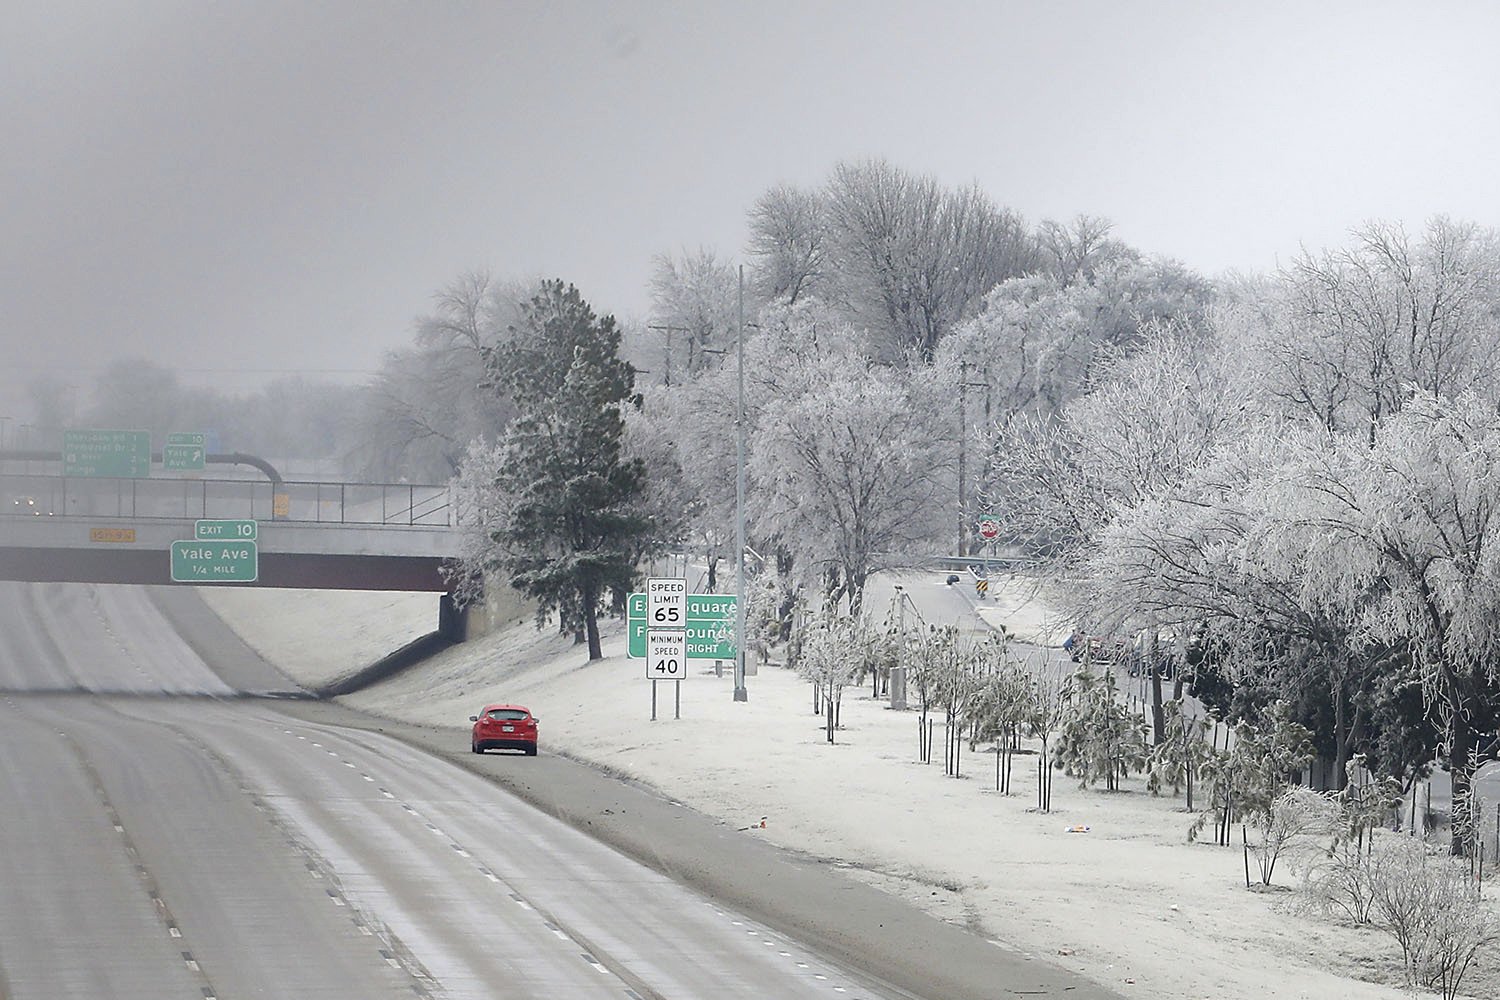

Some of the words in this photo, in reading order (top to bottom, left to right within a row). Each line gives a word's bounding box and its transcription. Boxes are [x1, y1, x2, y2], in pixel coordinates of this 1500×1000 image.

[192, 435, 203, 443] 10
[200, 526, 223, 535] EXIT
[236, 524, 253, 536] 10
[181, 549, 213, 560] Yale
[221, 549, 249, 560] Ave
[193, 565, 207, 575] 1/4
[651, 584, 684, 592] SPEED
[654, 596, 680, 604] LIMIT
[687, 602, 737, 615] quare
[654, 607, 680, 622] 65
[650, 636, 683, 644] MINIMUM
[654, 647, 679, 656] SPEED
[687, 644, 719, 653] RIGHT
[655, 659, 678, 674] 40
